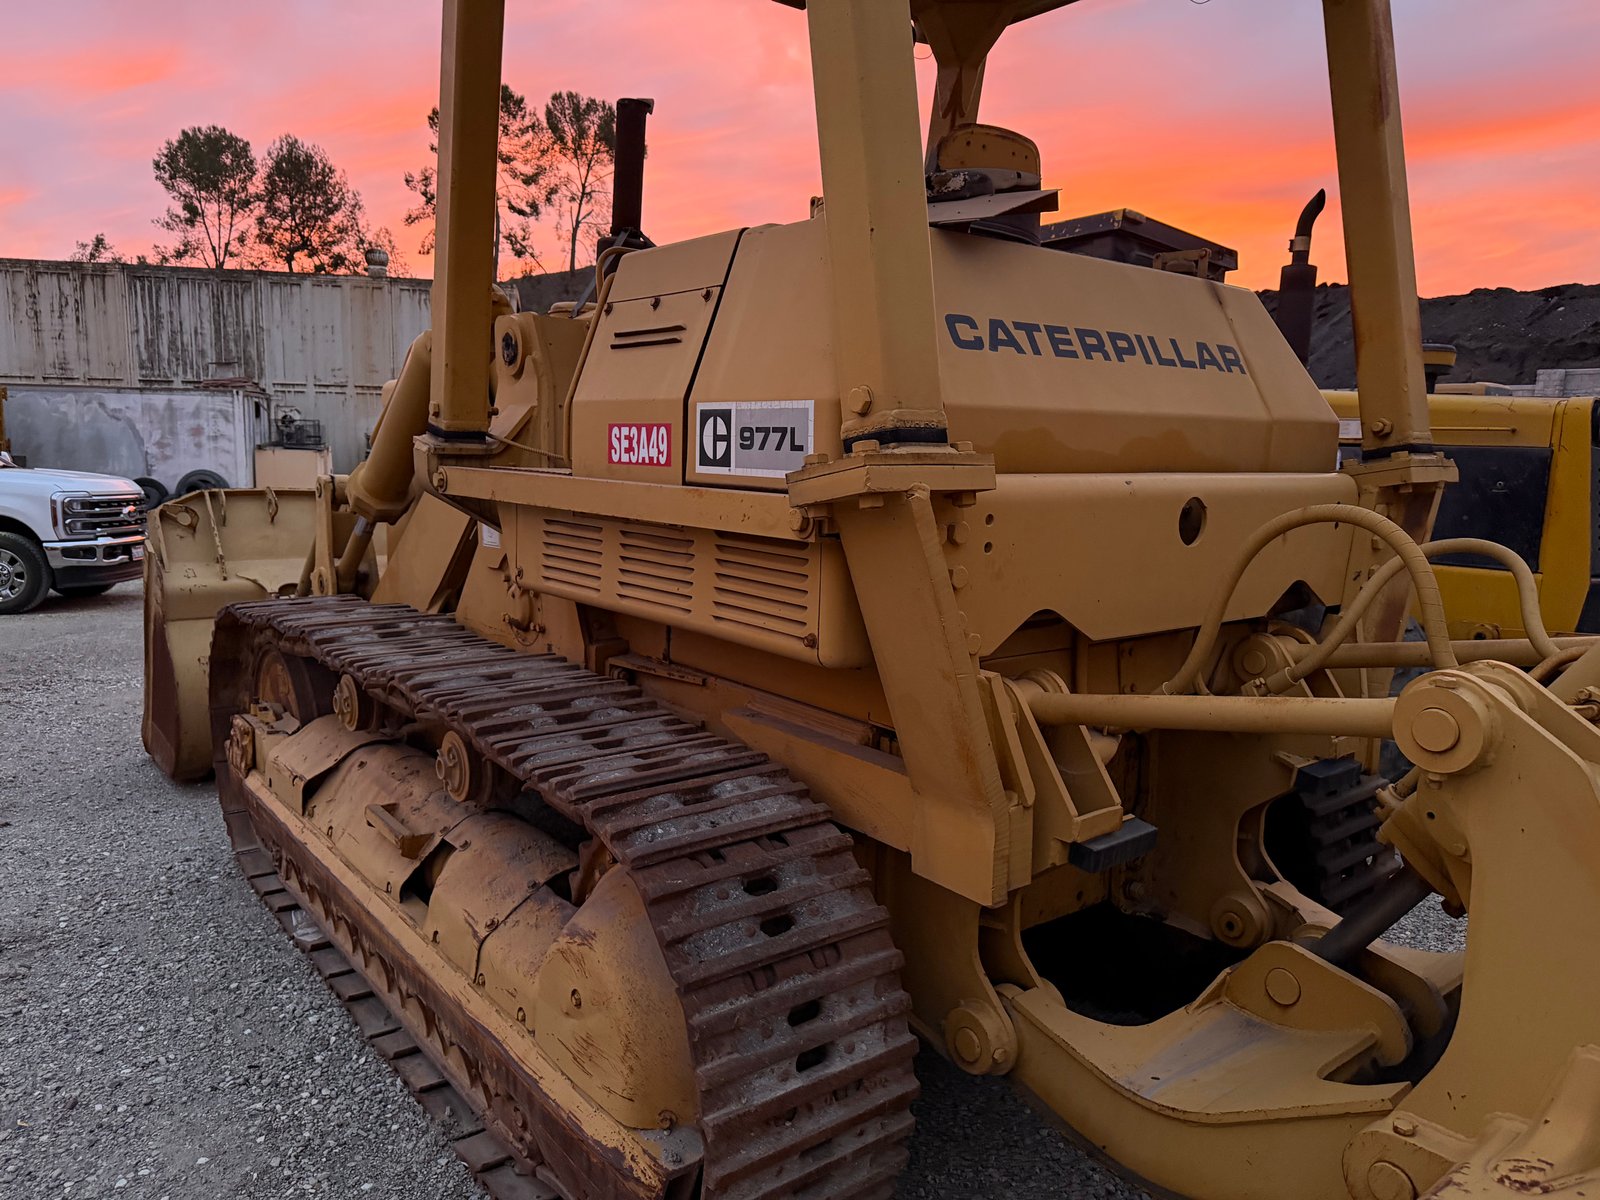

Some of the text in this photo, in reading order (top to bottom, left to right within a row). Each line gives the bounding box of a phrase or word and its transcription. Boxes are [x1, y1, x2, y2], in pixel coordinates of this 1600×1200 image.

[945, 314, 1247, 375] CATERPILLAR
[611, 426, 668, 465] SE3A49
[739, 426, 804, 452] 977L
